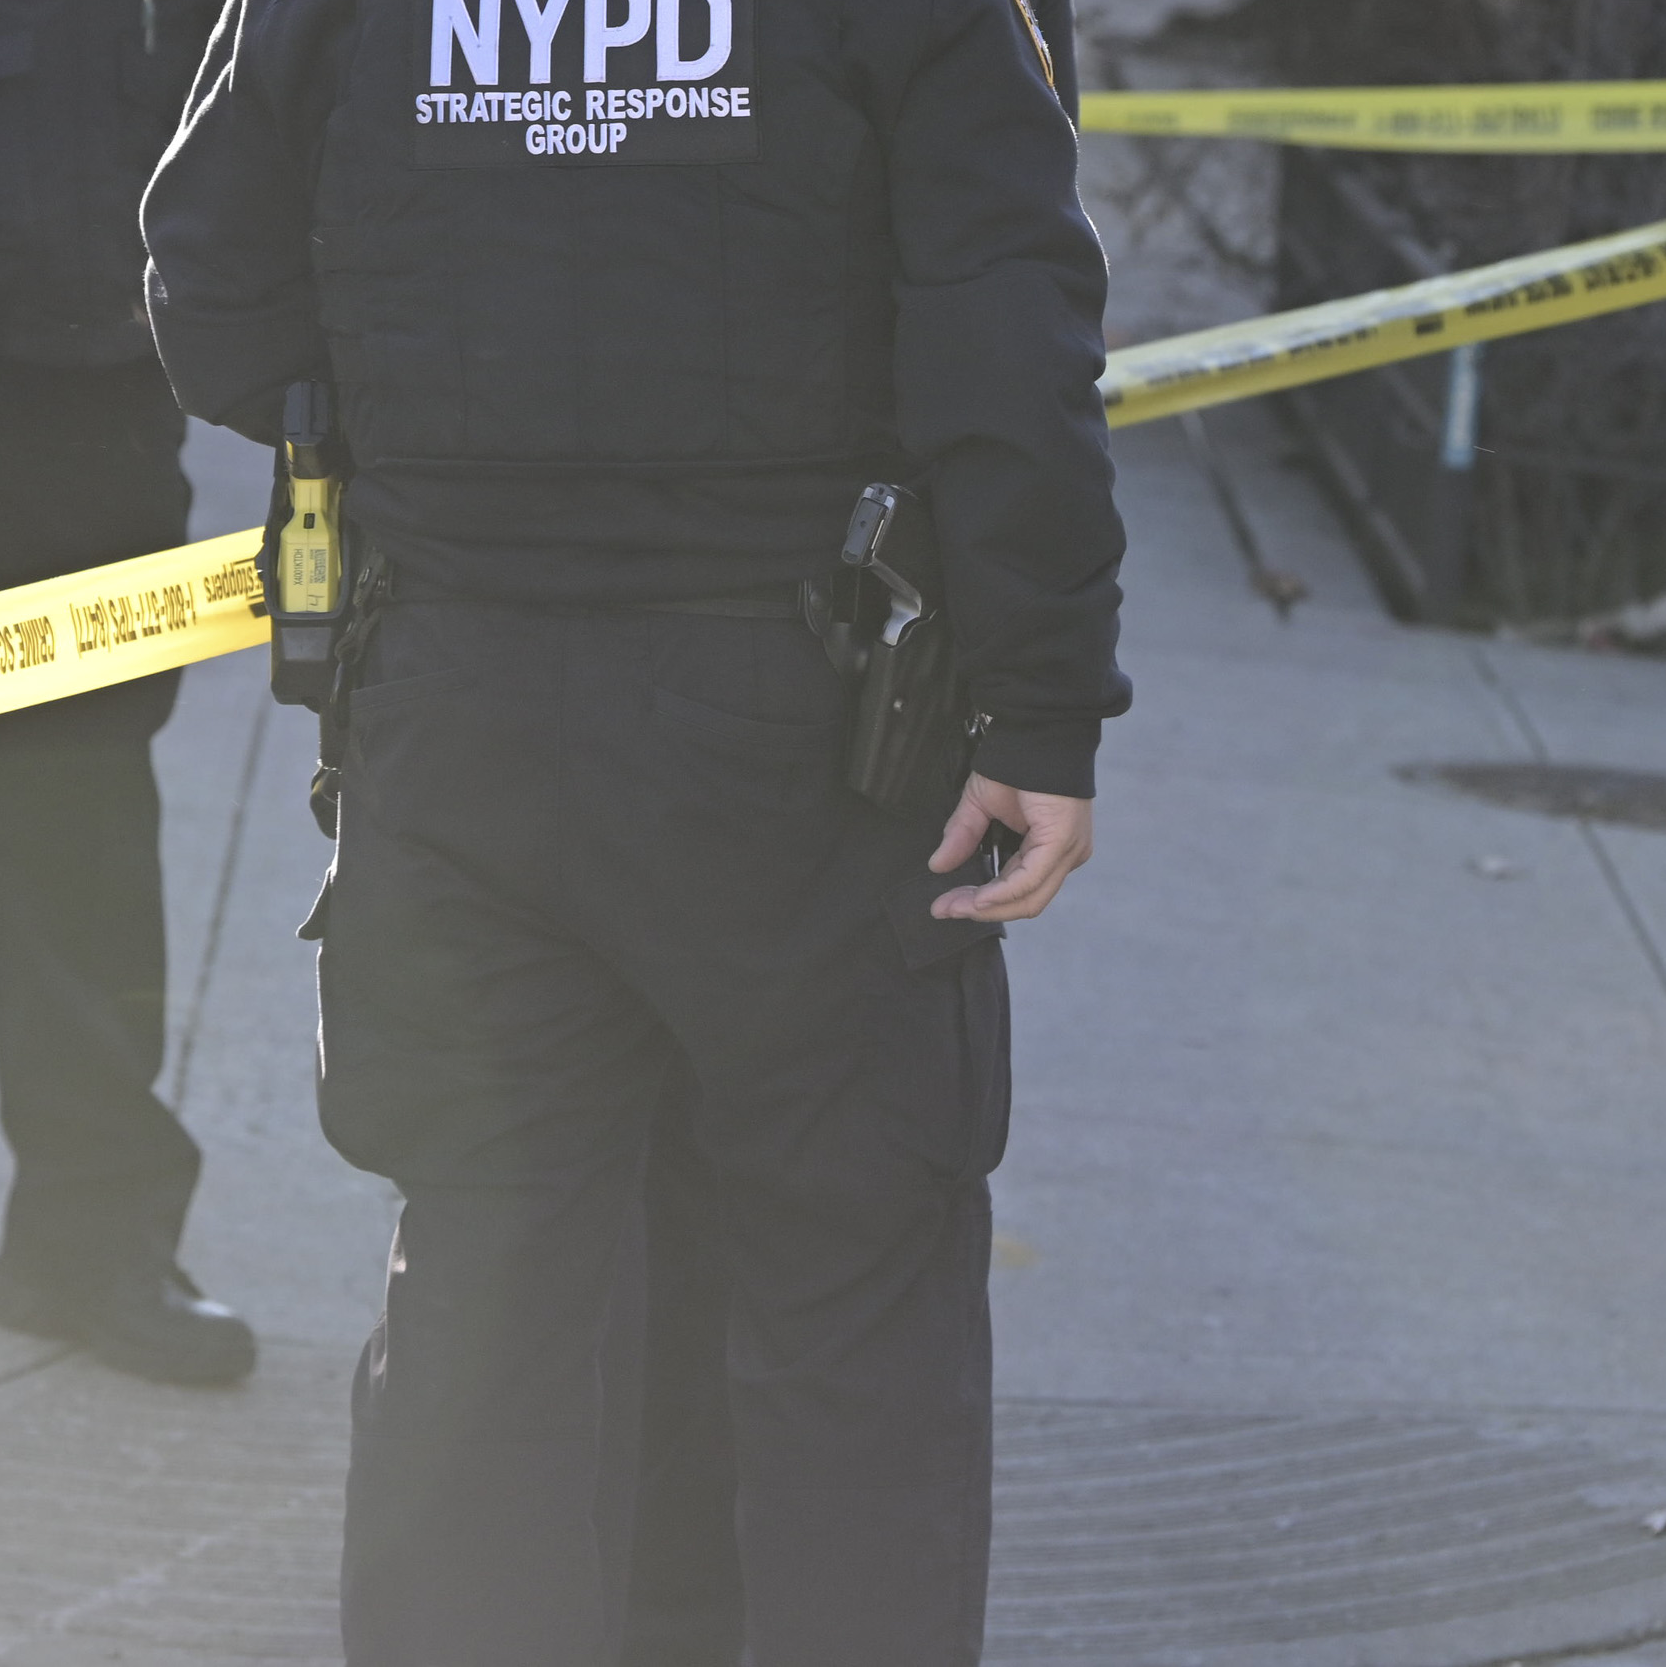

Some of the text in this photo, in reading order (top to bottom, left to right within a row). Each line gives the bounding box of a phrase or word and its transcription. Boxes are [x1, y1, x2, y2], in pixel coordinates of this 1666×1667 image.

[415, 87, 751, 124] STRATEGIC RESPONSE
[525, 122, 627, 155] GROUP
[14, 616, 55, 669] CRIME
[69, 582, 197, 659] 1-800-577-TIPS (8477)
